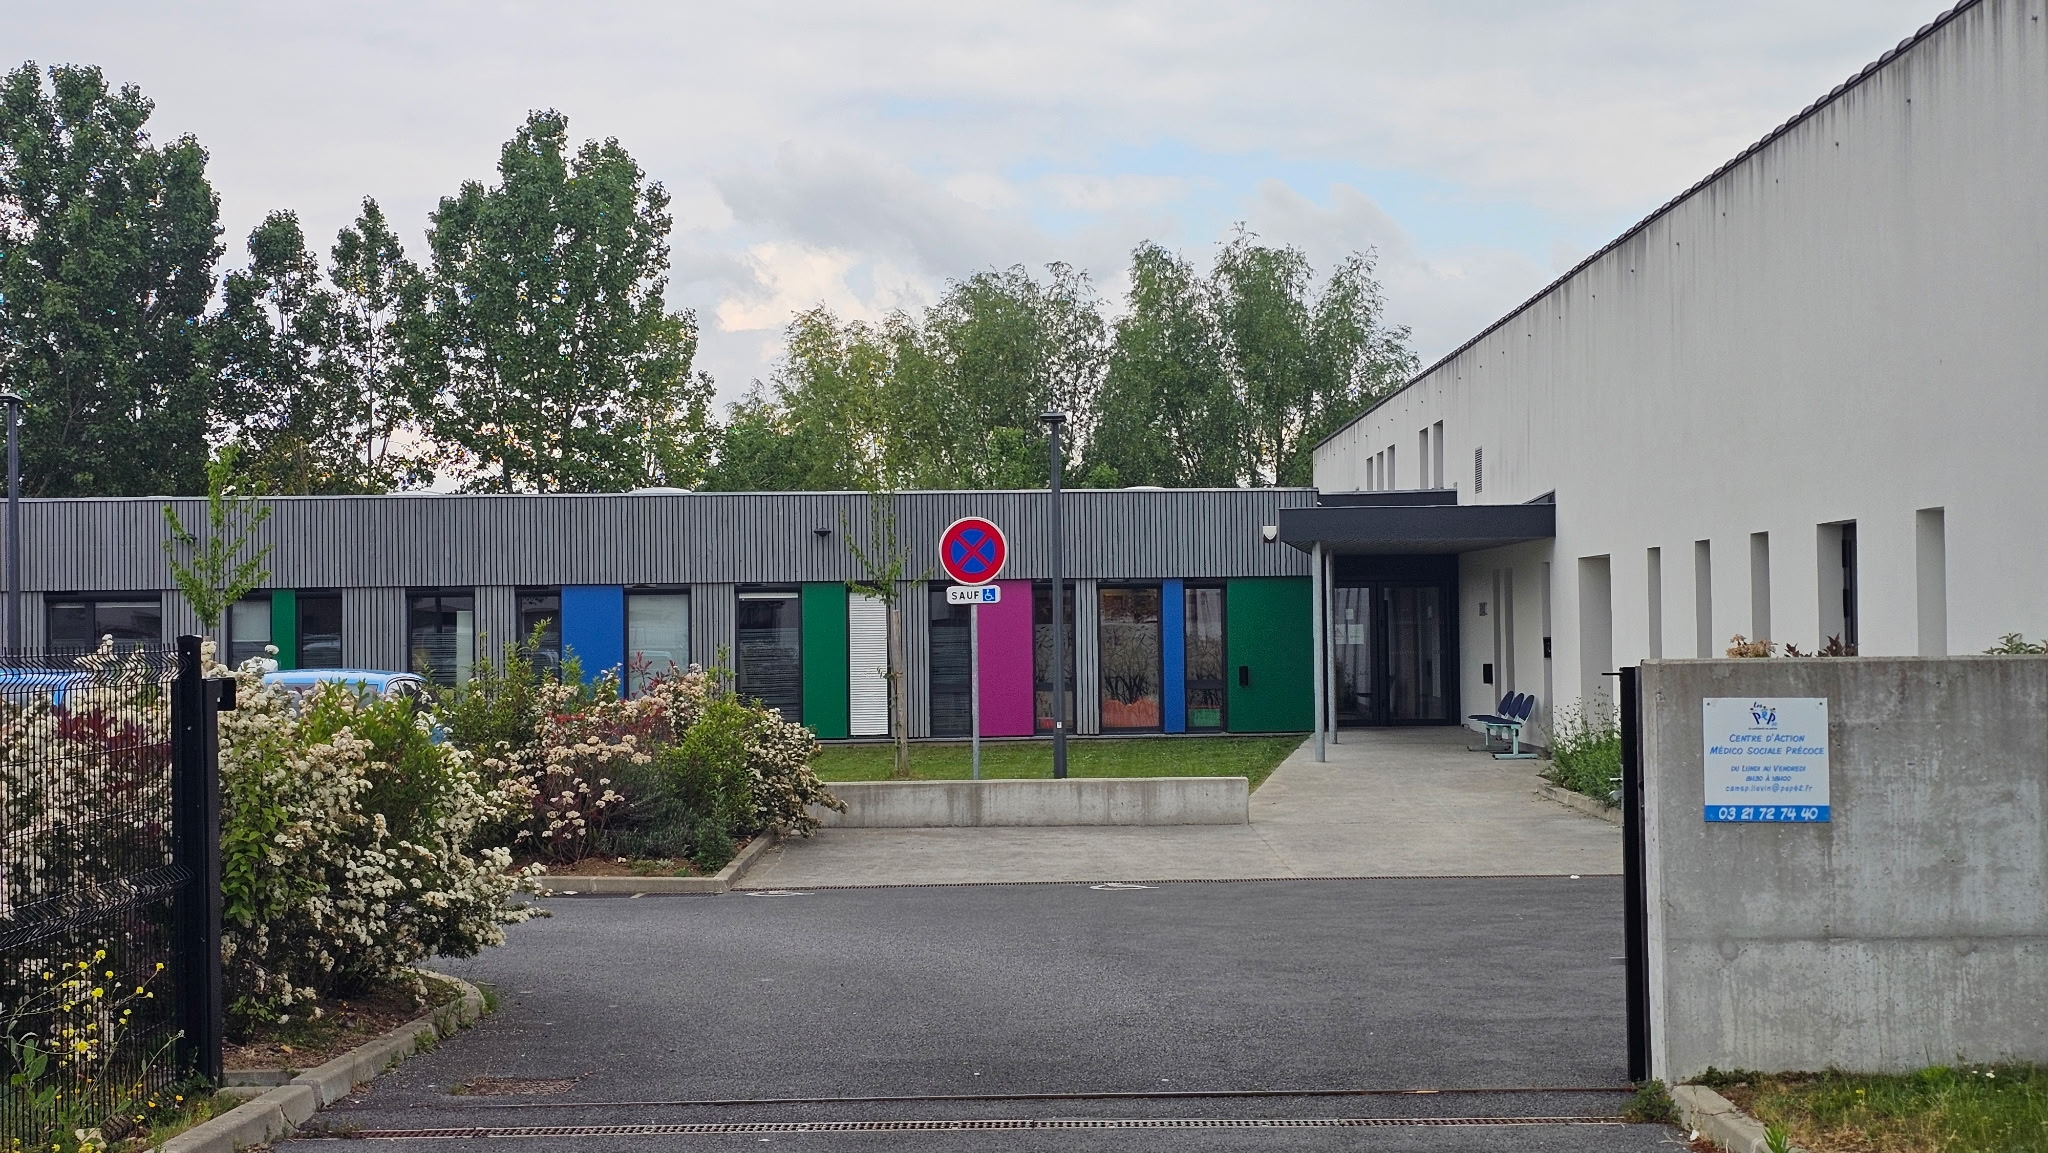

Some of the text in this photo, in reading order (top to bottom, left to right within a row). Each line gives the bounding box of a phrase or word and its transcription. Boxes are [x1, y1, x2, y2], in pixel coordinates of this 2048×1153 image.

[951, 591, 980, 600] SAUF
[1729, 733, 1805, 743] CENTRE D'ACTION
[1709, 745, 1825, 755] MÉDICO SOCIALE PRÉCOCE
[1718, 807, 1818, 820] 03 21 72 74 40
